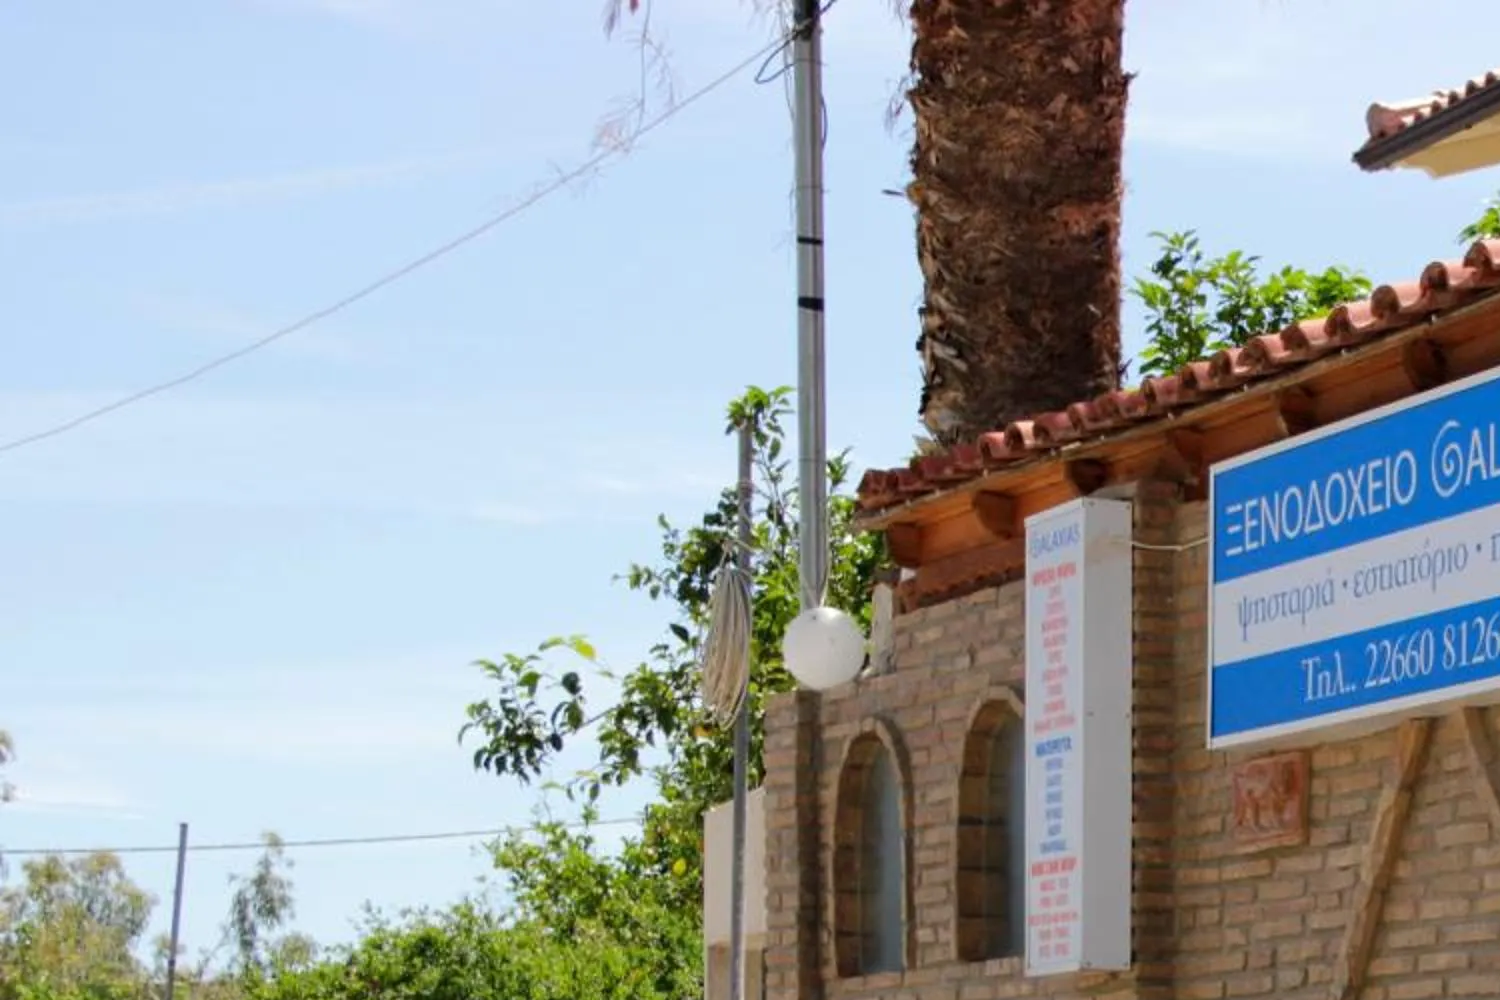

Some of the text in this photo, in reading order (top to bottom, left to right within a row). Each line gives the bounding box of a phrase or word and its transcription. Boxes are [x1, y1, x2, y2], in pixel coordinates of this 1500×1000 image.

[1225, 450, 1417, 557] ΞΕΝΟΔΟΧΕΙΟ
[1237, 567, 1335, 641] ψησταριά
[1353, 538, 1468, 599] εστιατόριο
[1364, 628, 1434, 689] 22660
